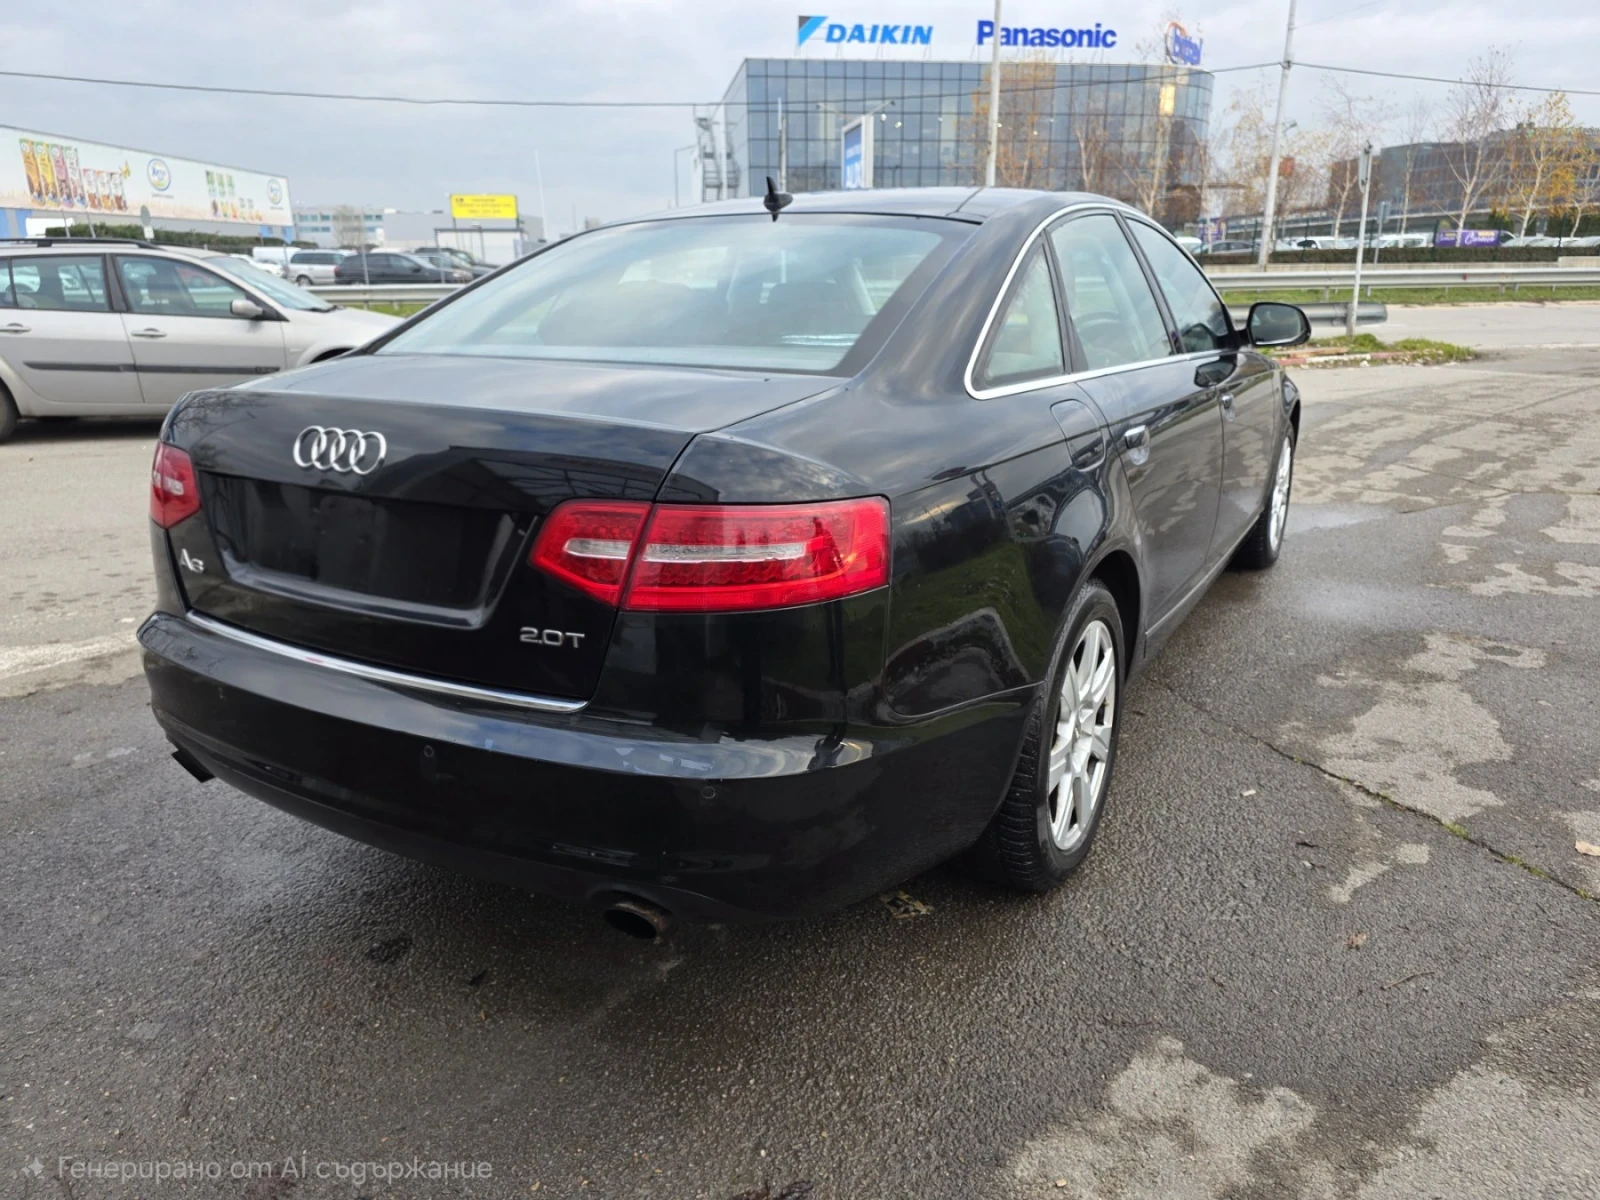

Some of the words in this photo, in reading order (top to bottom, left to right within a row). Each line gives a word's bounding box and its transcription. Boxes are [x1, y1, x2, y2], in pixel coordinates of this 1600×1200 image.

[825, 24, 933, 45] DAIKIN
[977, 20, 1117, 48] Panasonic
[180, 548, 204, 573] A6
